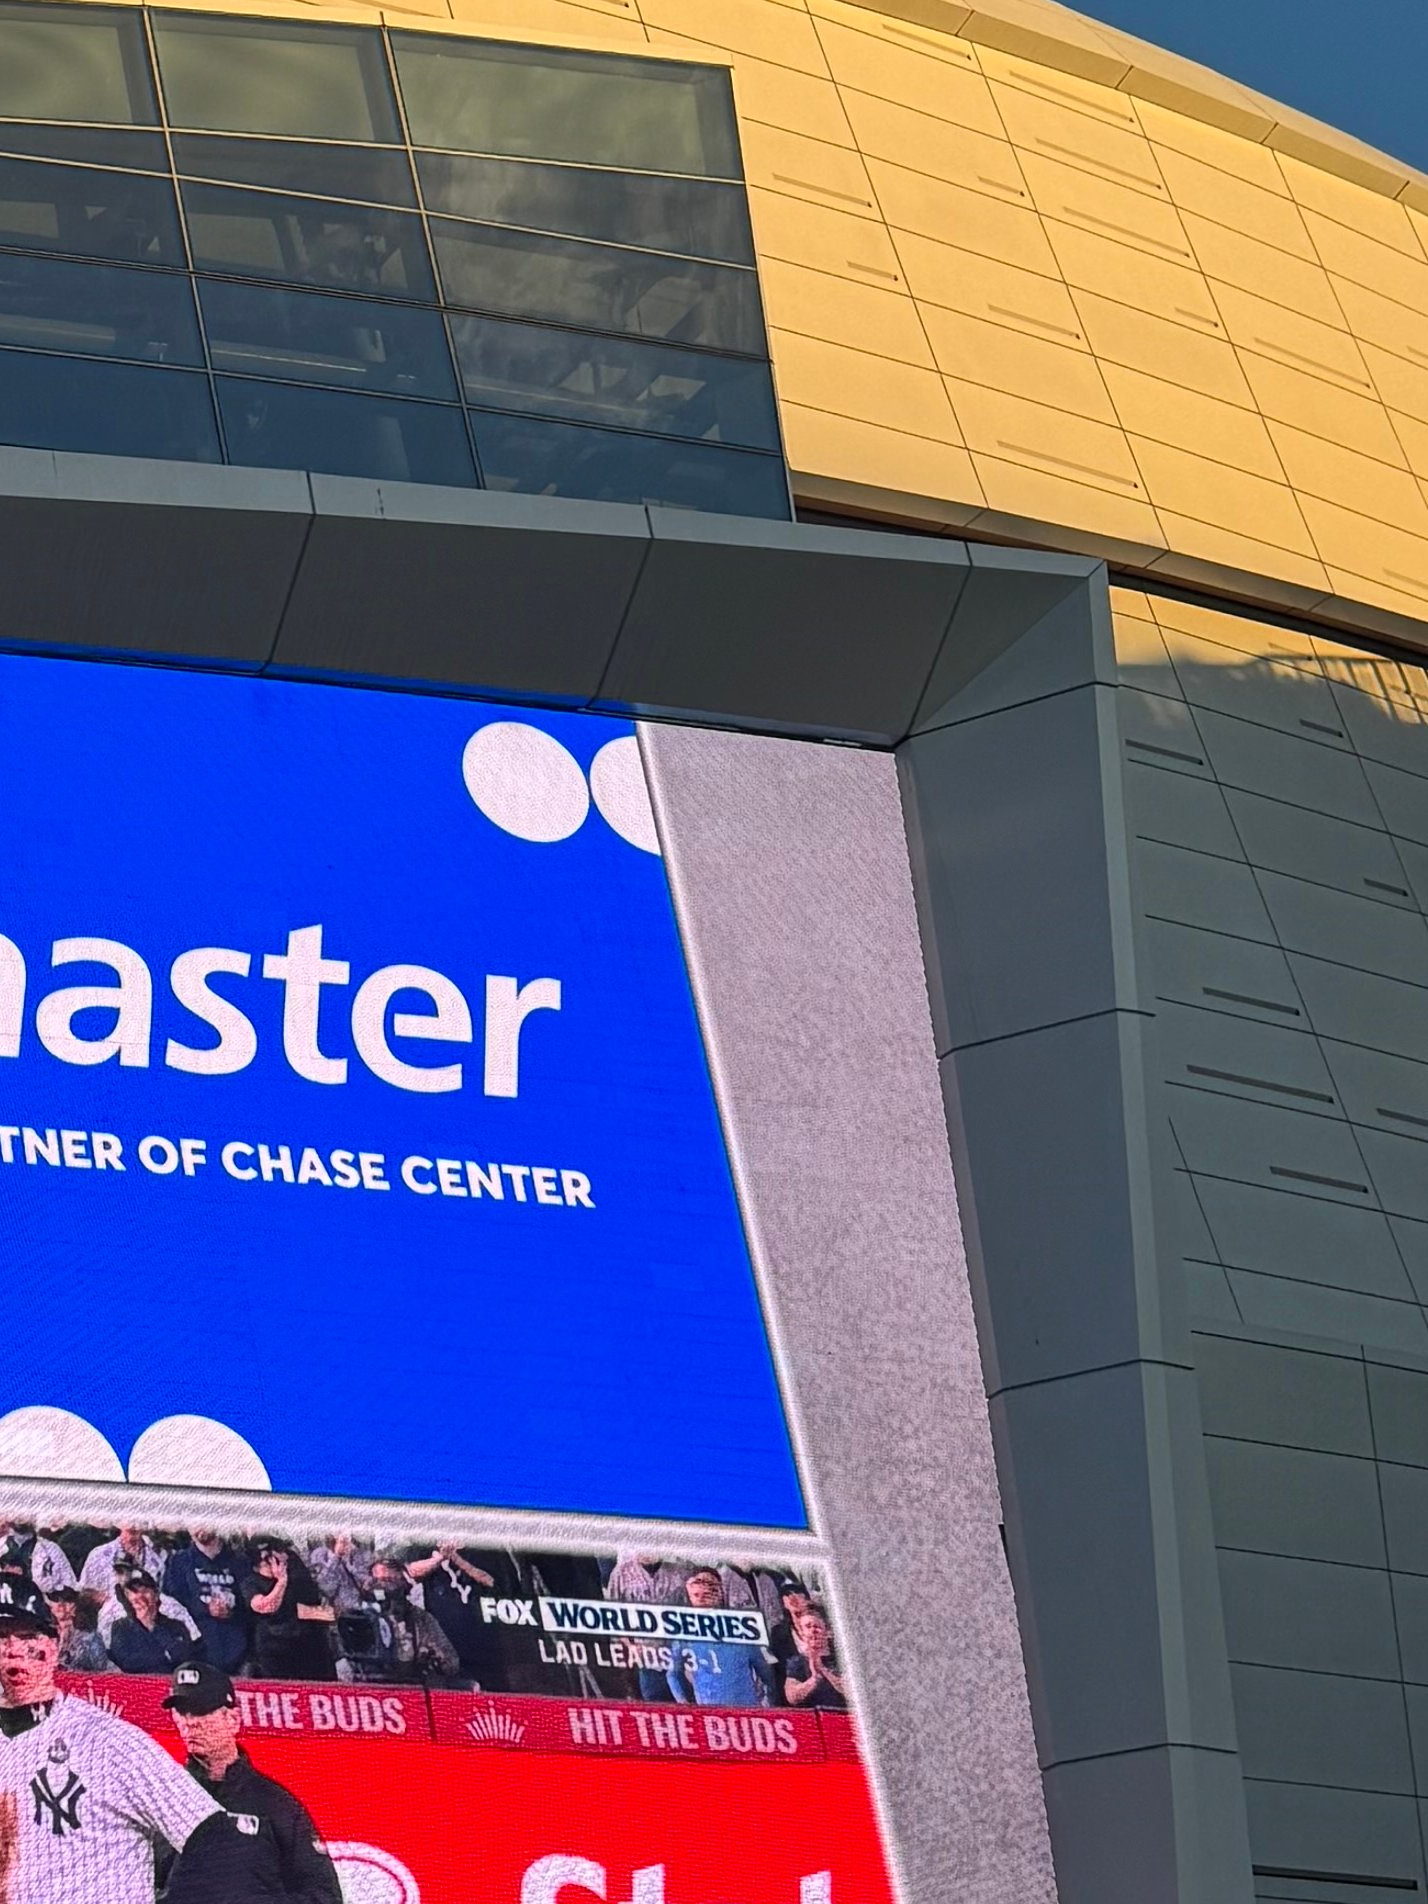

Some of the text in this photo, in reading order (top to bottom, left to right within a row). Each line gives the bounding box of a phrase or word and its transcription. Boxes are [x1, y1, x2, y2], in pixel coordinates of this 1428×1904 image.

[137, 1134, 207, 1178] OF
[221, 1140, 390, 1192] CHASE
[399, 1154, 596, 1210] CENTER
[480, 1597, 762, 1641] FOX WORLD SERIES
[538, 1639, 723, 1674] LAD LEADS 3-1
[239, 1689, 407, 1736] THE BUDS
[568, 1706, 799, 1756] HIT THE BUDS
